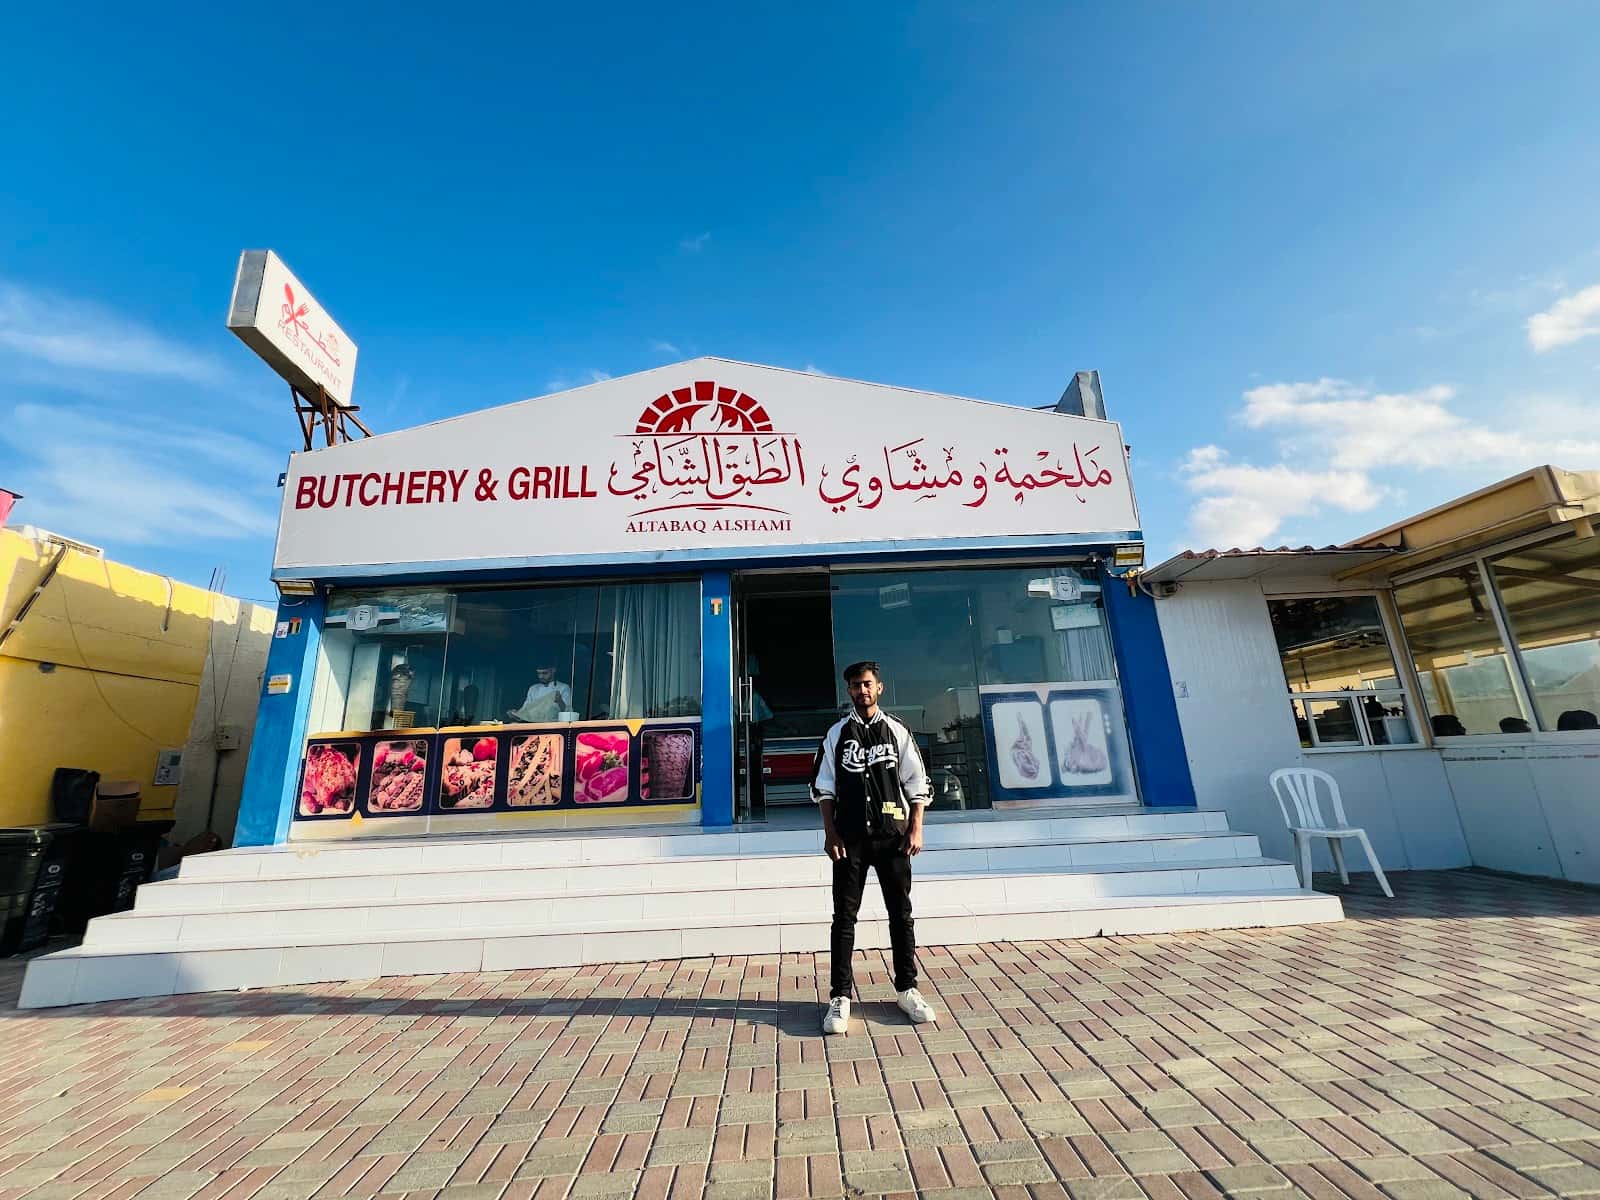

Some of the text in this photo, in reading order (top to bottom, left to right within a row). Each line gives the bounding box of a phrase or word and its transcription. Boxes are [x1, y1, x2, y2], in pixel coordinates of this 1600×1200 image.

[277, 319, 343, 391] RESTAURANT
[296, 465, 599, 510] BUTCHERY & GRILL
[626, 519, 793, 533] ALTABAQ ALSHAMI
